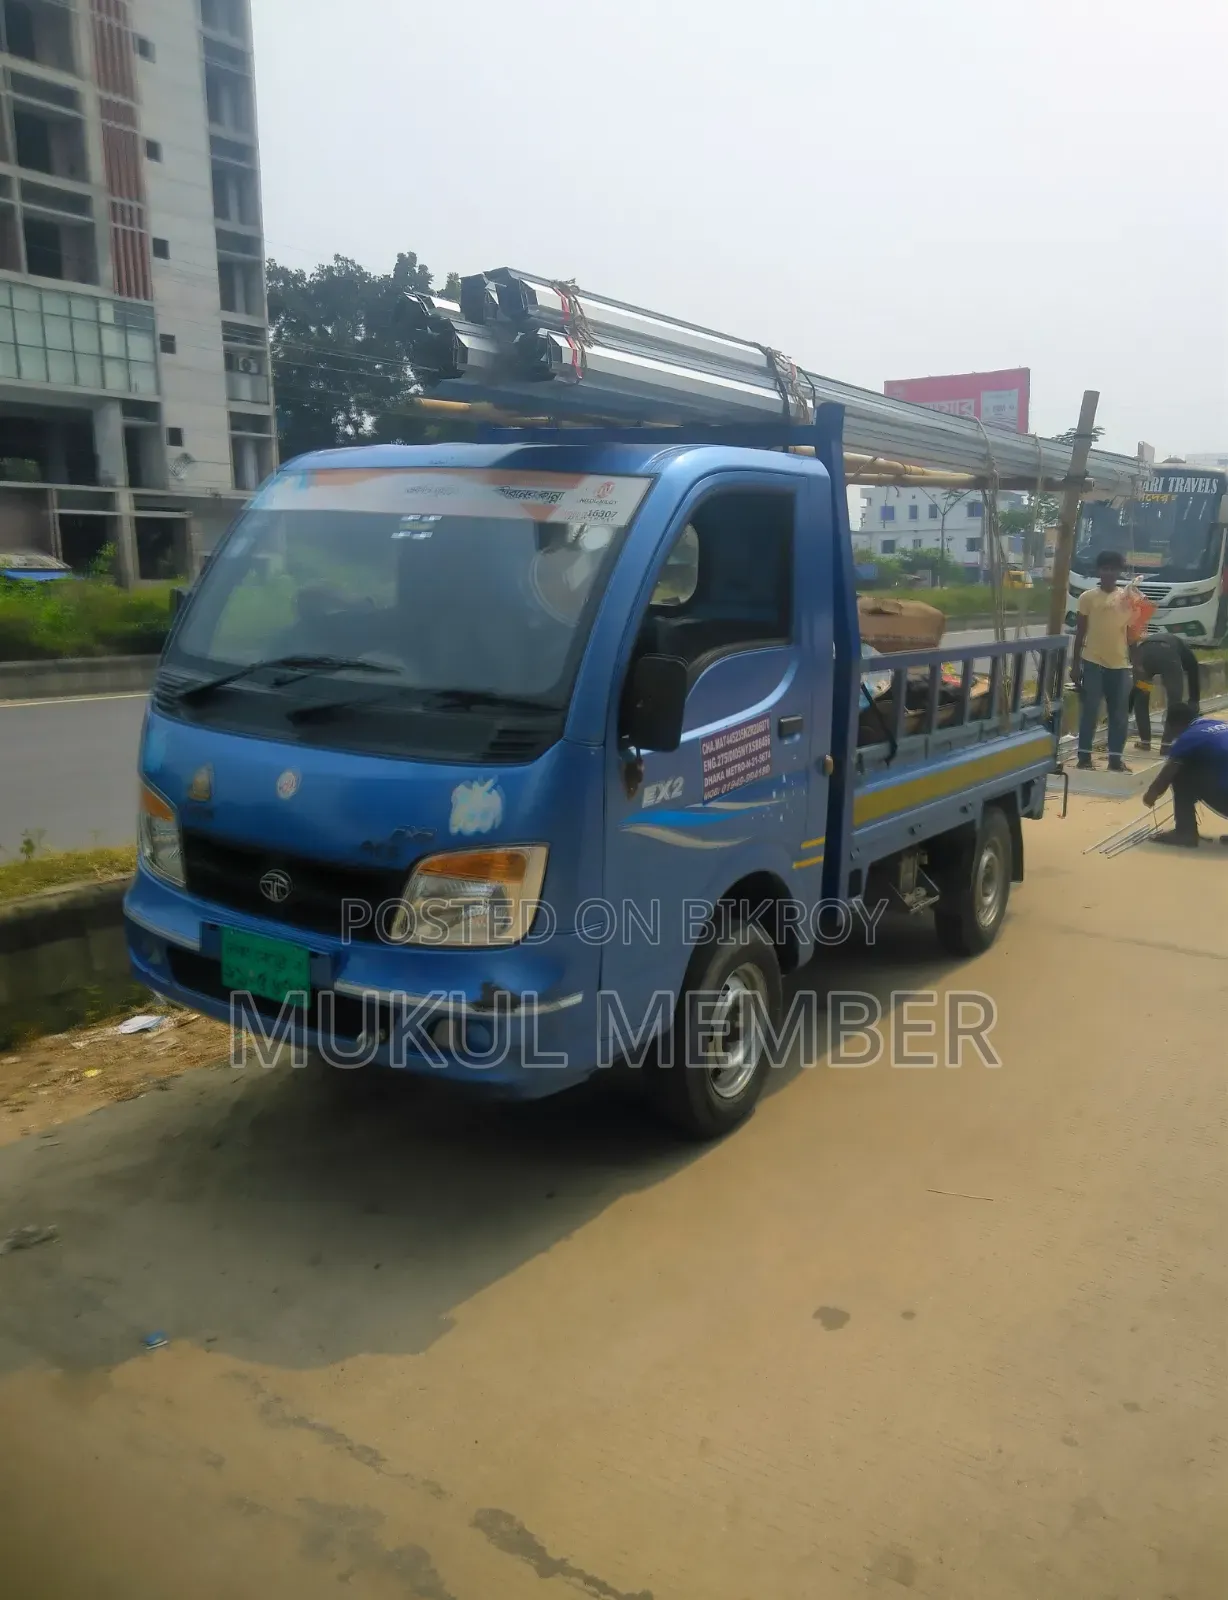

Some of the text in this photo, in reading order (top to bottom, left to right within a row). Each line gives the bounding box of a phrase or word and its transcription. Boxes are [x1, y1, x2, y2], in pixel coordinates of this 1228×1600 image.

[1168, 477, 1218, 494] TRAVELS
[704, 771, 725, 787] DHAKA
[642, 776, 684, 808] EX2
